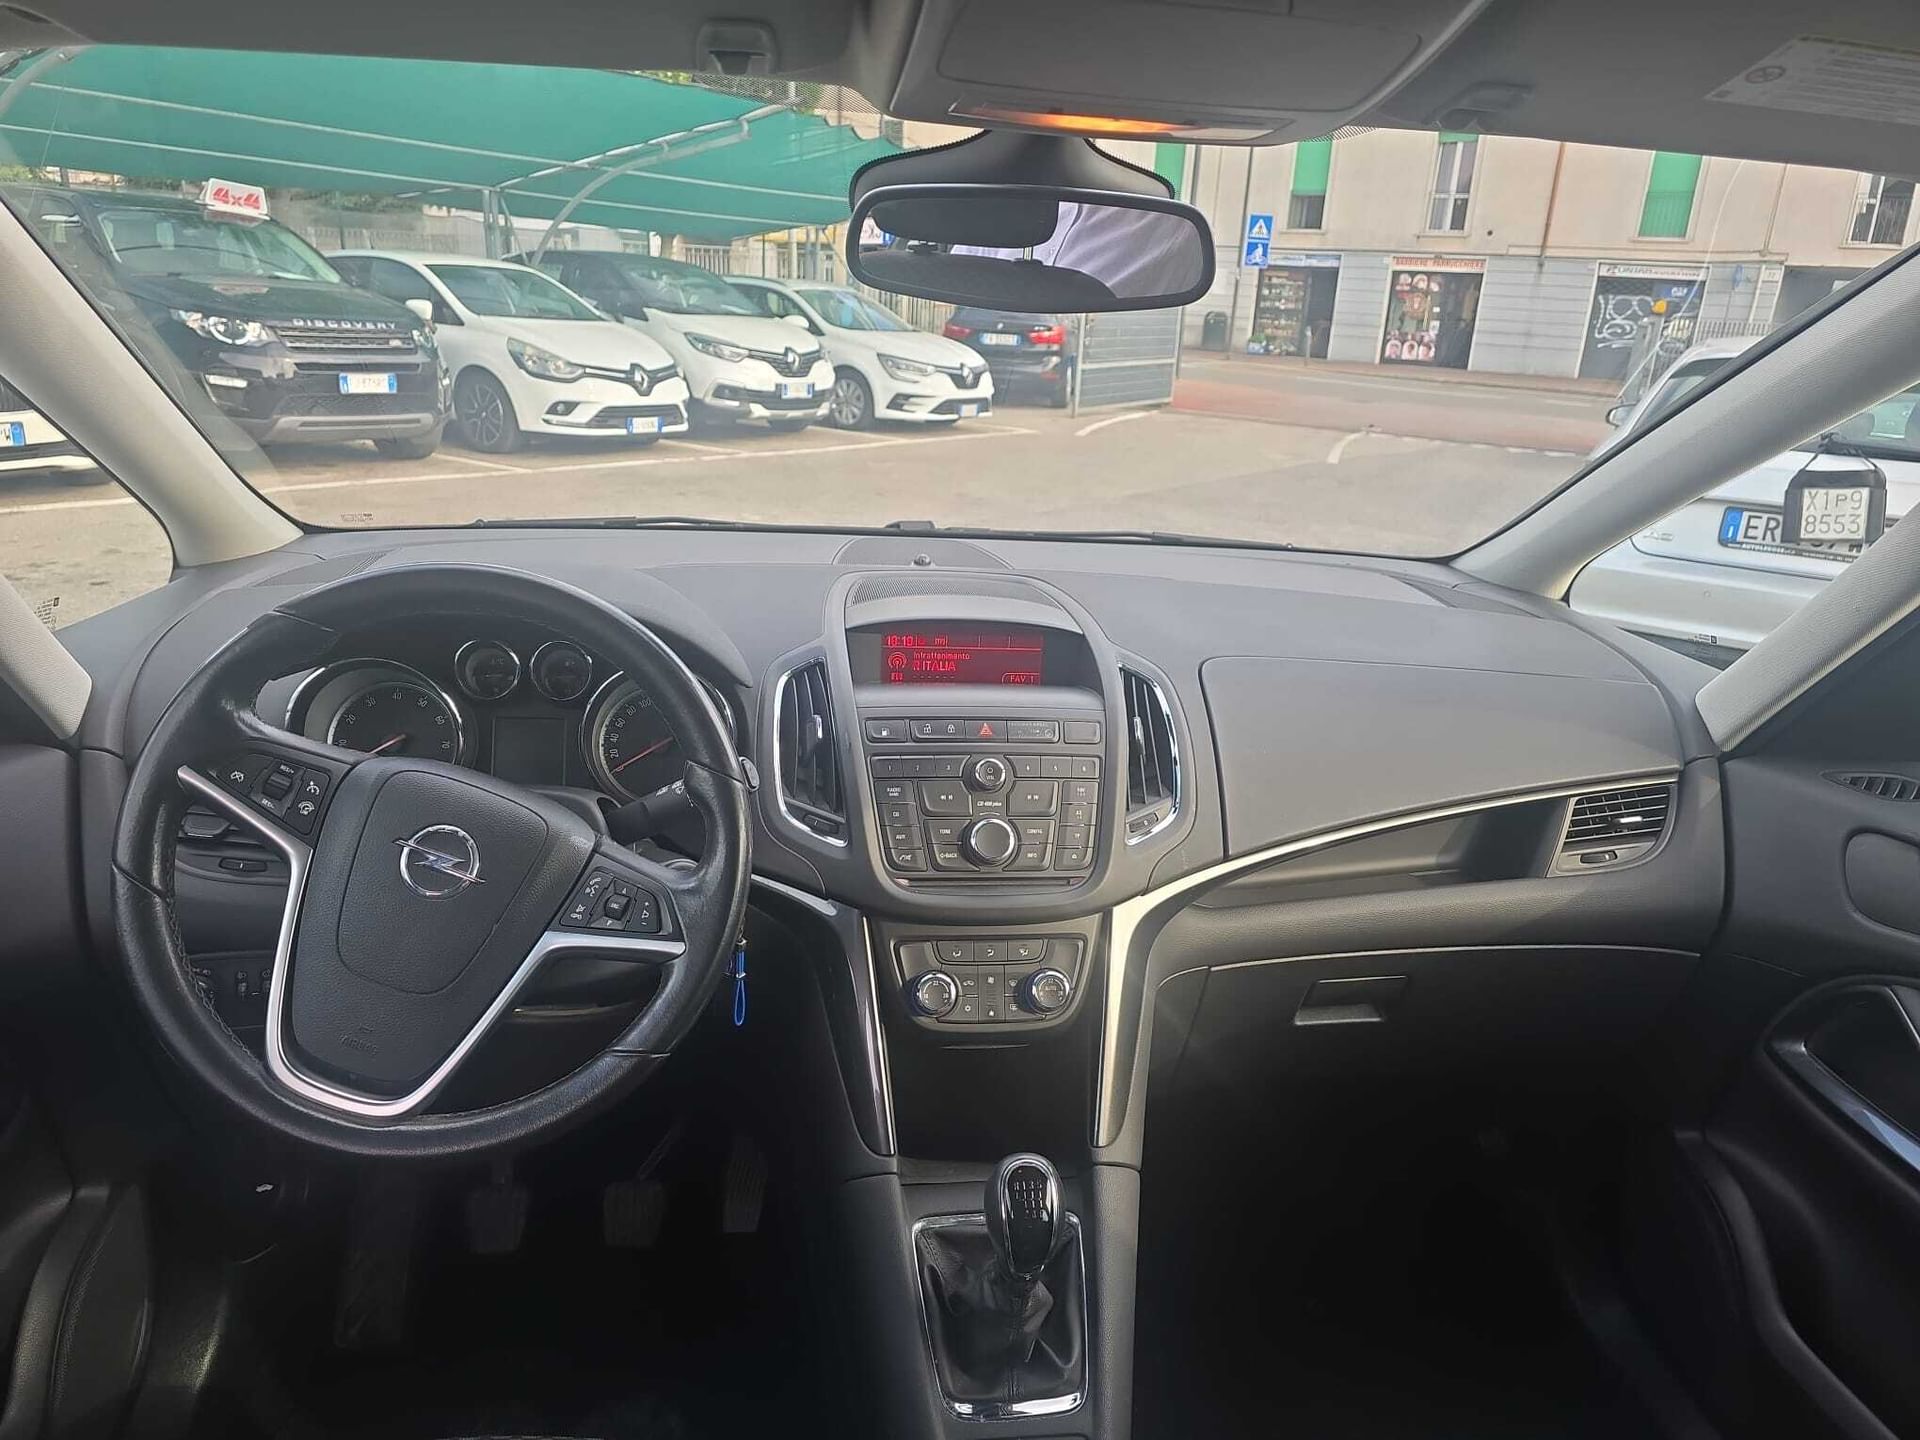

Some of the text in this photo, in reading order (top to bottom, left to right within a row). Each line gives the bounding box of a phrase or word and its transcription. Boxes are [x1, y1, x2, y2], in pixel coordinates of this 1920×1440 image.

[212, 187, 261, 210] 4x4
[292, 318, 397, 330] DISCOVERY
[1807, 490, 1863, 512] X1P9
[1804, 513, 1862, 535] 8553
[392, 692, 402, 700] 40
[346, 714, 356, 725] 20
[609, 733, 619, 743] 40
[609, 748, 619, 759] 20
